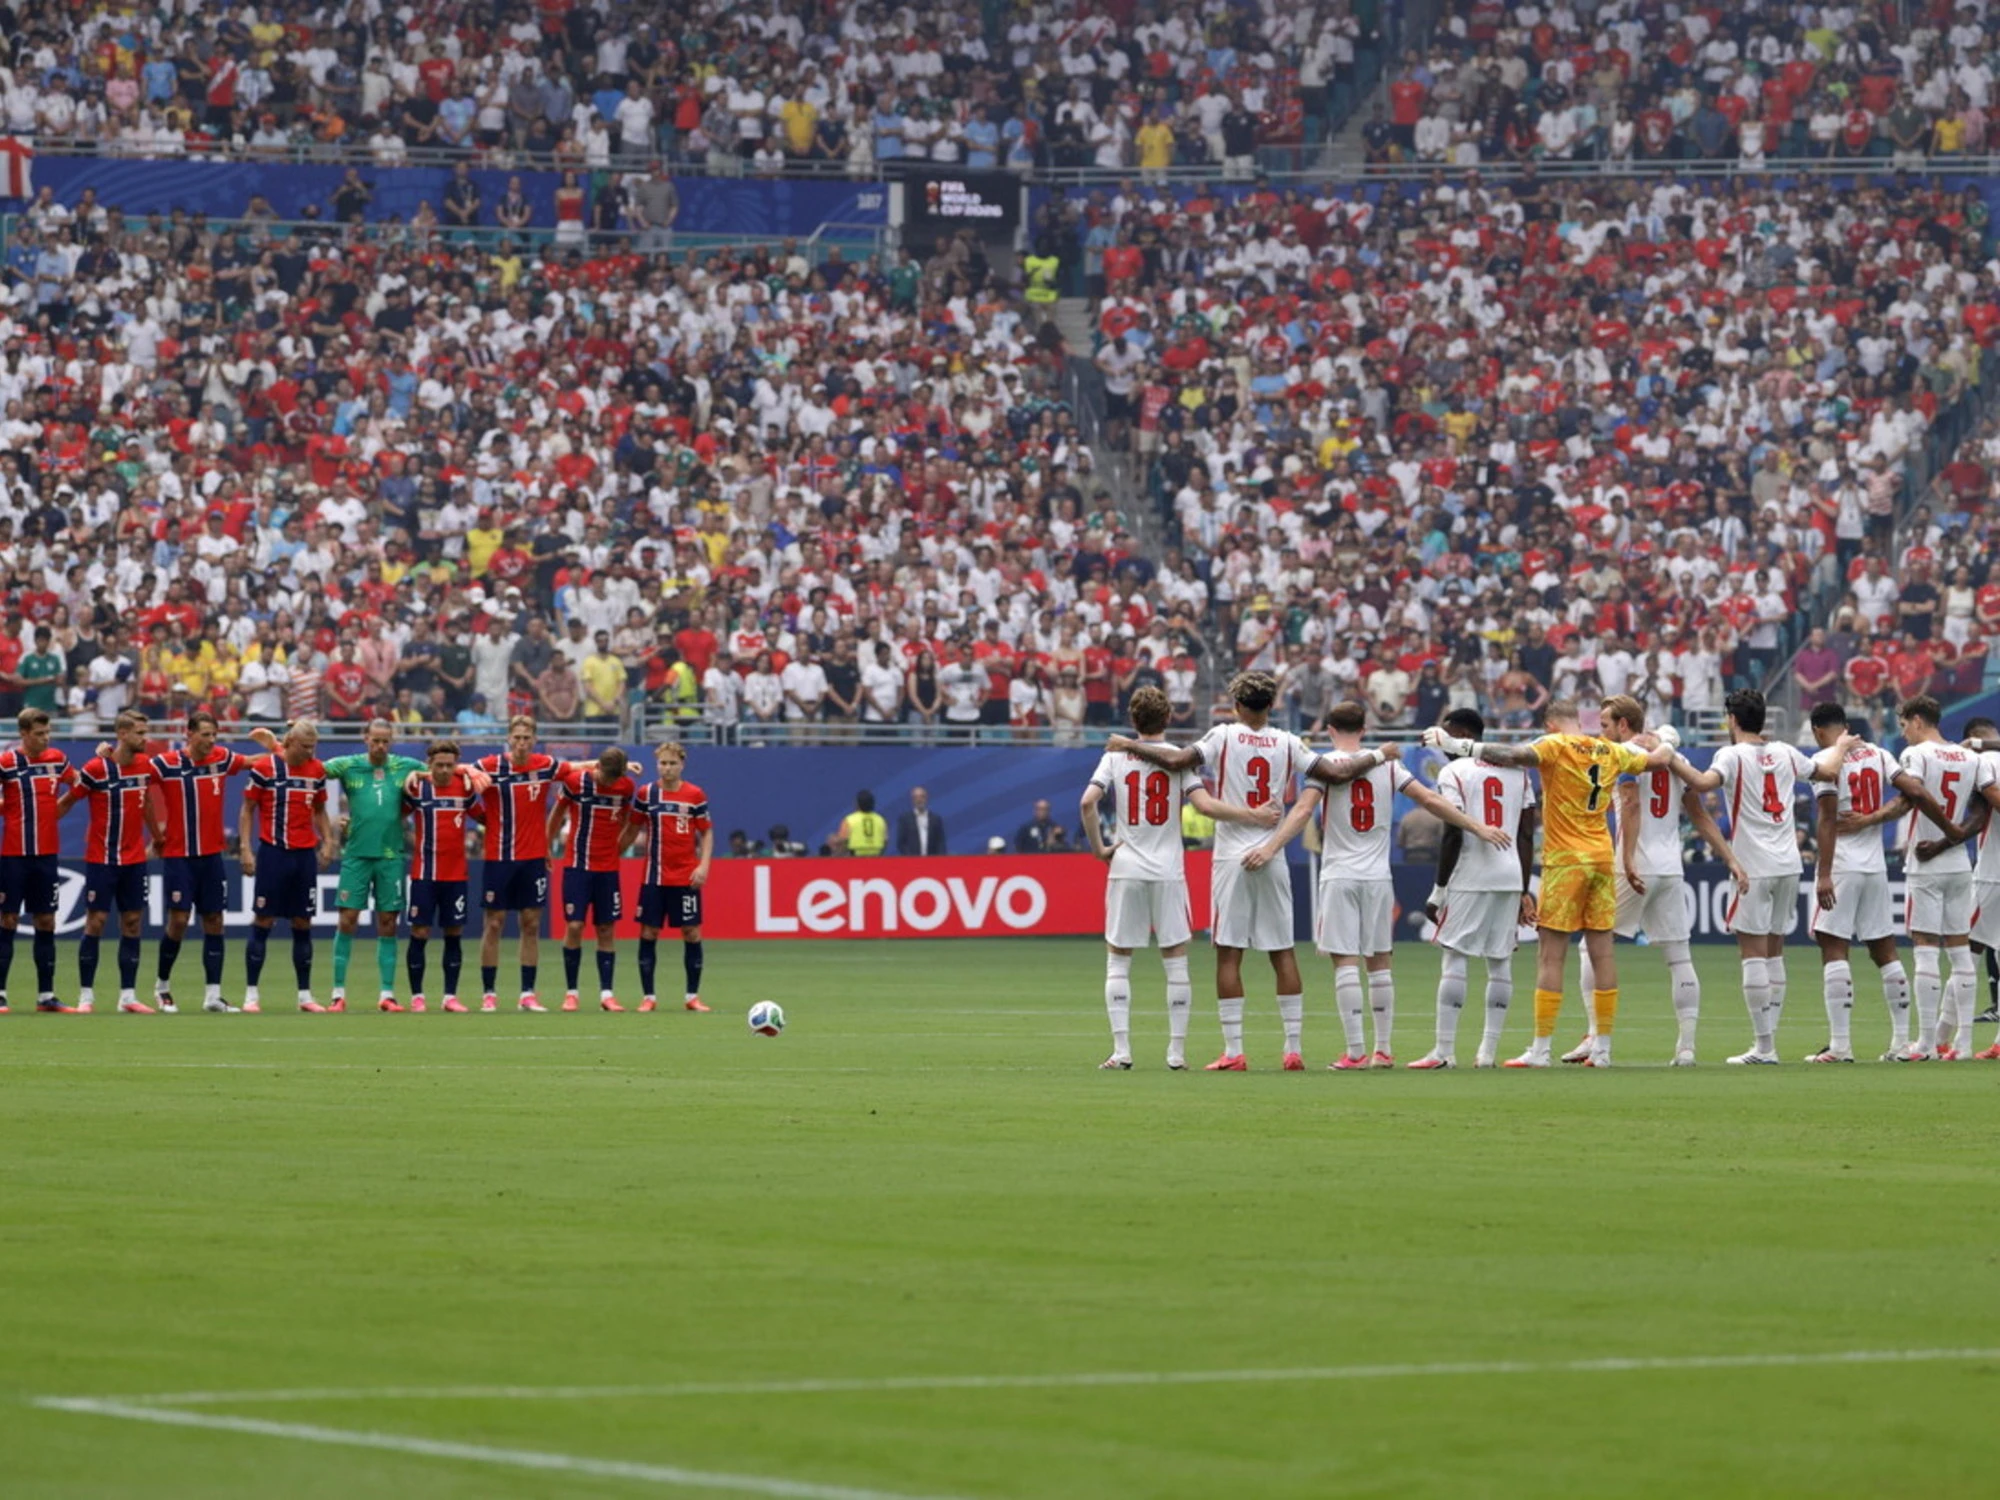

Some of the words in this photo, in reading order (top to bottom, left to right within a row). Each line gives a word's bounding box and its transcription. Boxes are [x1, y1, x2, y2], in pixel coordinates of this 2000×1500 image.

[376, 788, 384, 806] 1
[527, 783, 542, 801] 17
[1125, 770, 1169, 826] 18
[1247, 756, 1270, 808] 3
[1351, 777, 1374, 832] 8
[1483, 776, 1503, 828] 6
[1588, 764, 1601, 811] 1
[1650, 768, 1669, 818] 9
[1848, 767, 1880, 815] 10
[1940, 770, 1960, 820] 5
[454, 813, 463, 829] 6
[395, 879, 402, 897] 1
[455, 895, 465, 913] 6
[682, 895, 697, 913] 21
[755, 865, 1047, 932] Lenovo
